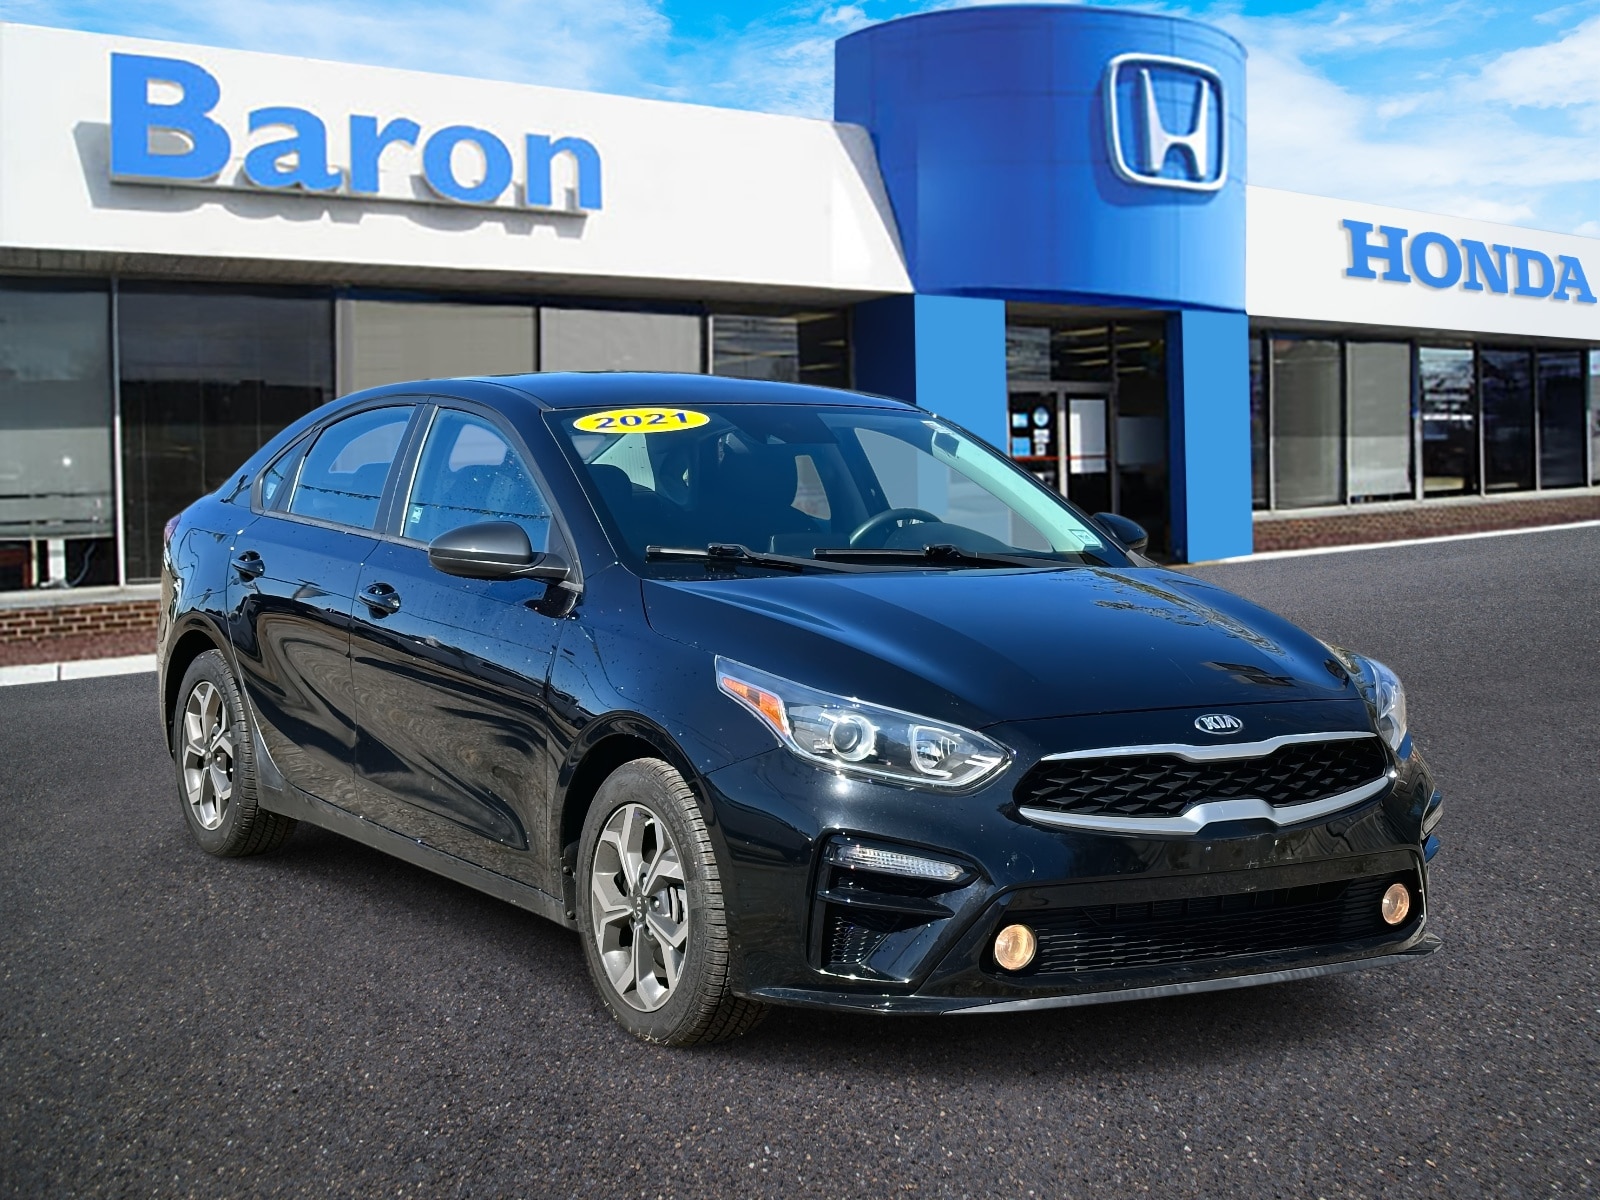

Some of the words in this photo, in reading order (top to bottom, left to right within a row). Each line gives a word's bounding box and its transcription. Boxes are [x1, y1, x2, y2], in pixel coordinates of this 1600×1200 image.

[110, 52, 603, 211] Baron
[1342, 218, 1598, 304] HONDA
[593, 412, 688, 430] 2021
[1200, 715, 1239, 730] KIA
